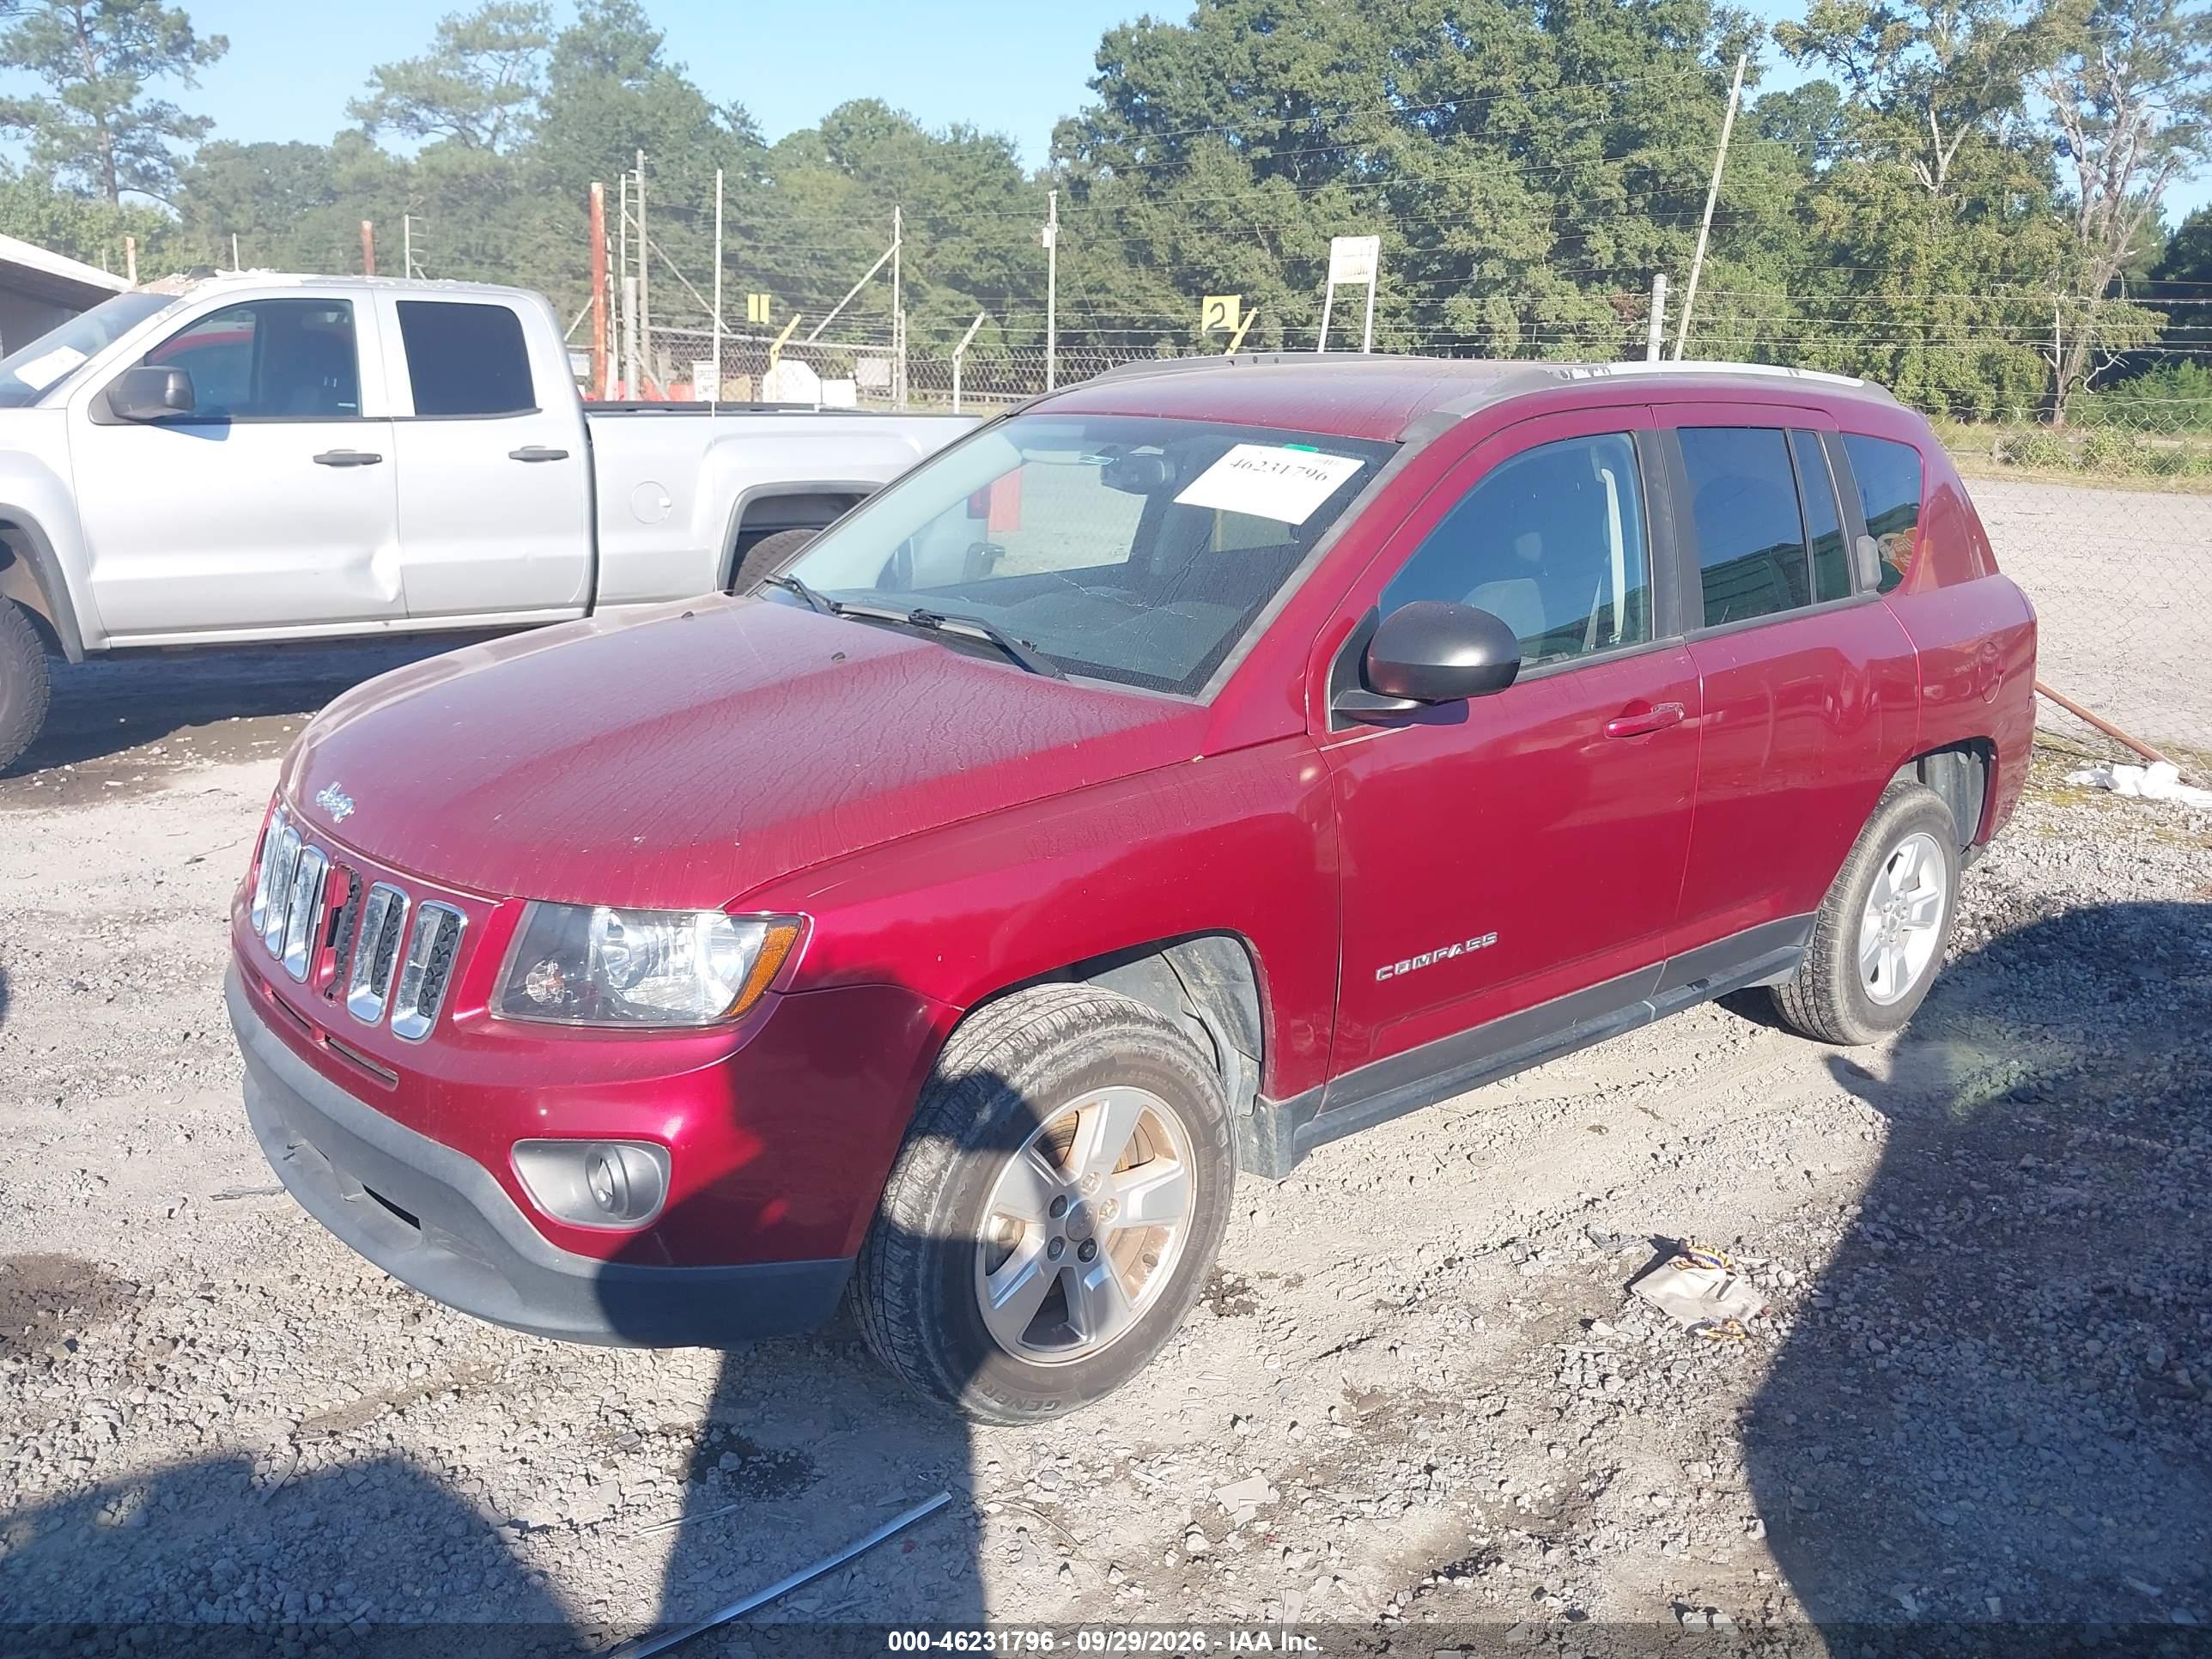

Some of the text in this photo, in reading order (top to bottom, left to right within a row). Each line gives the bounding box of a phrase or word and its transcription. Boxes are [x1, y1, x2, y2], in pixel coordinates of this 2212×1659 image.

[1206, 302, 1231, 331] 2
[1230, 459, 1328, 482] 46231796
[1376, 931, 1498, 981] COMPASS
